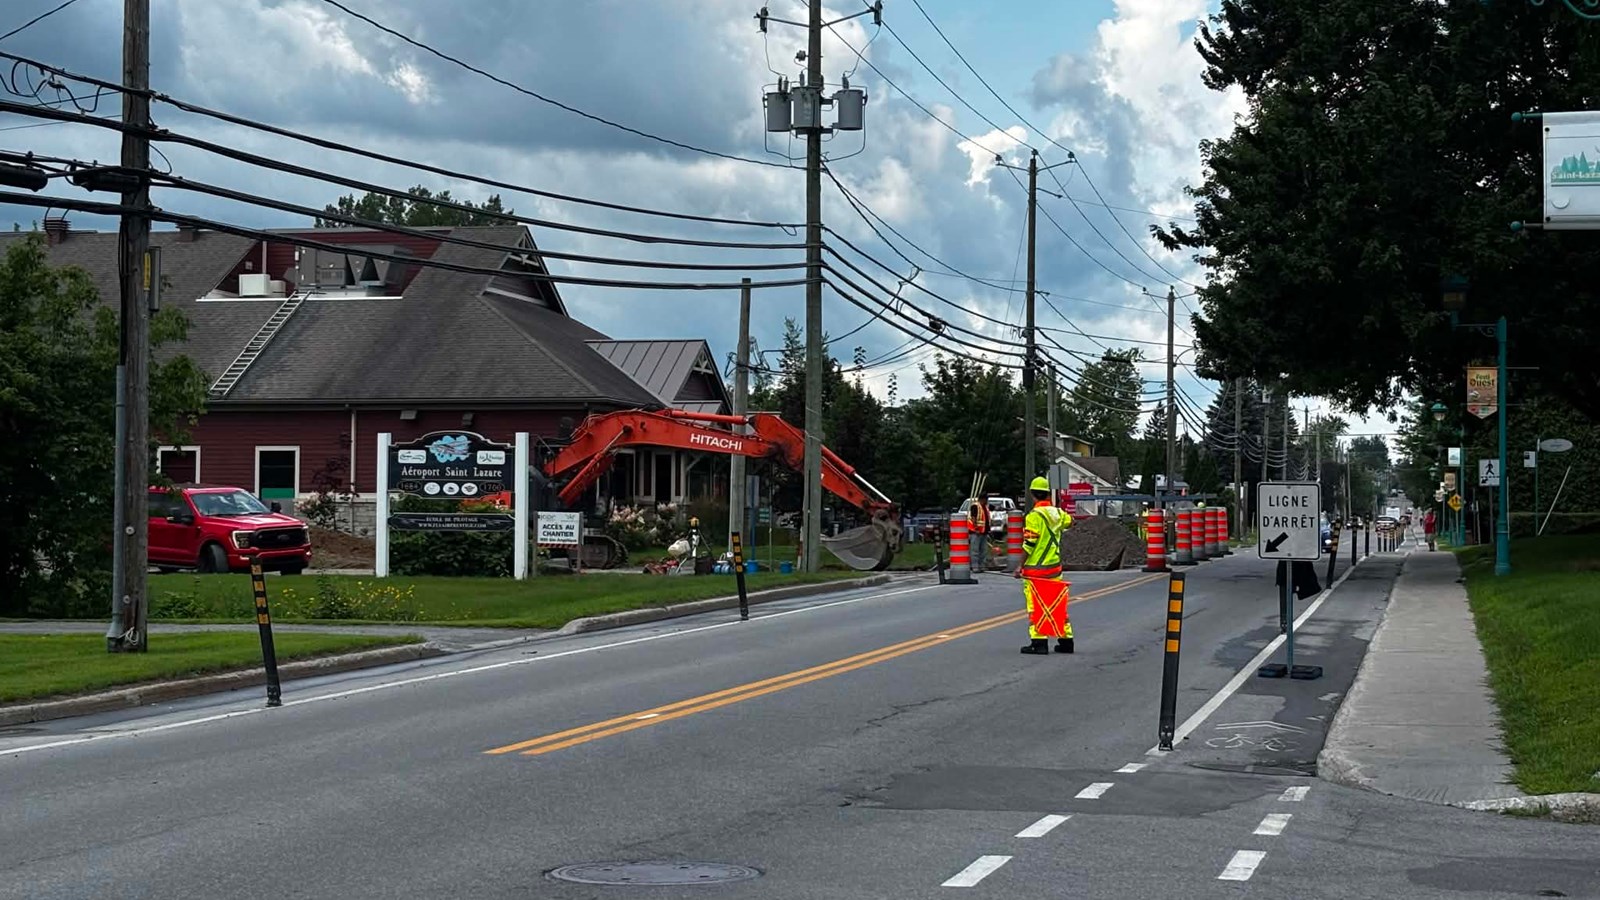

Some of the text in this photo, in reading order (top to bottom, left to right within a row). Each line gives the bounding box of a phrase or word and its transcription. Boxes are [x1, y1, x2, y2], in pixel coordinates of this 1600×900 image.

[1469, 378, 1495, 387] Ouest
[690, 433, 743, 451] HITACHI
[401, 466, 503, 479] Aéroport Saint Lazare
[1269, 495, 1308, 507] LIGNE
[1263, 514, 1315, 528] D'ARRÊT
